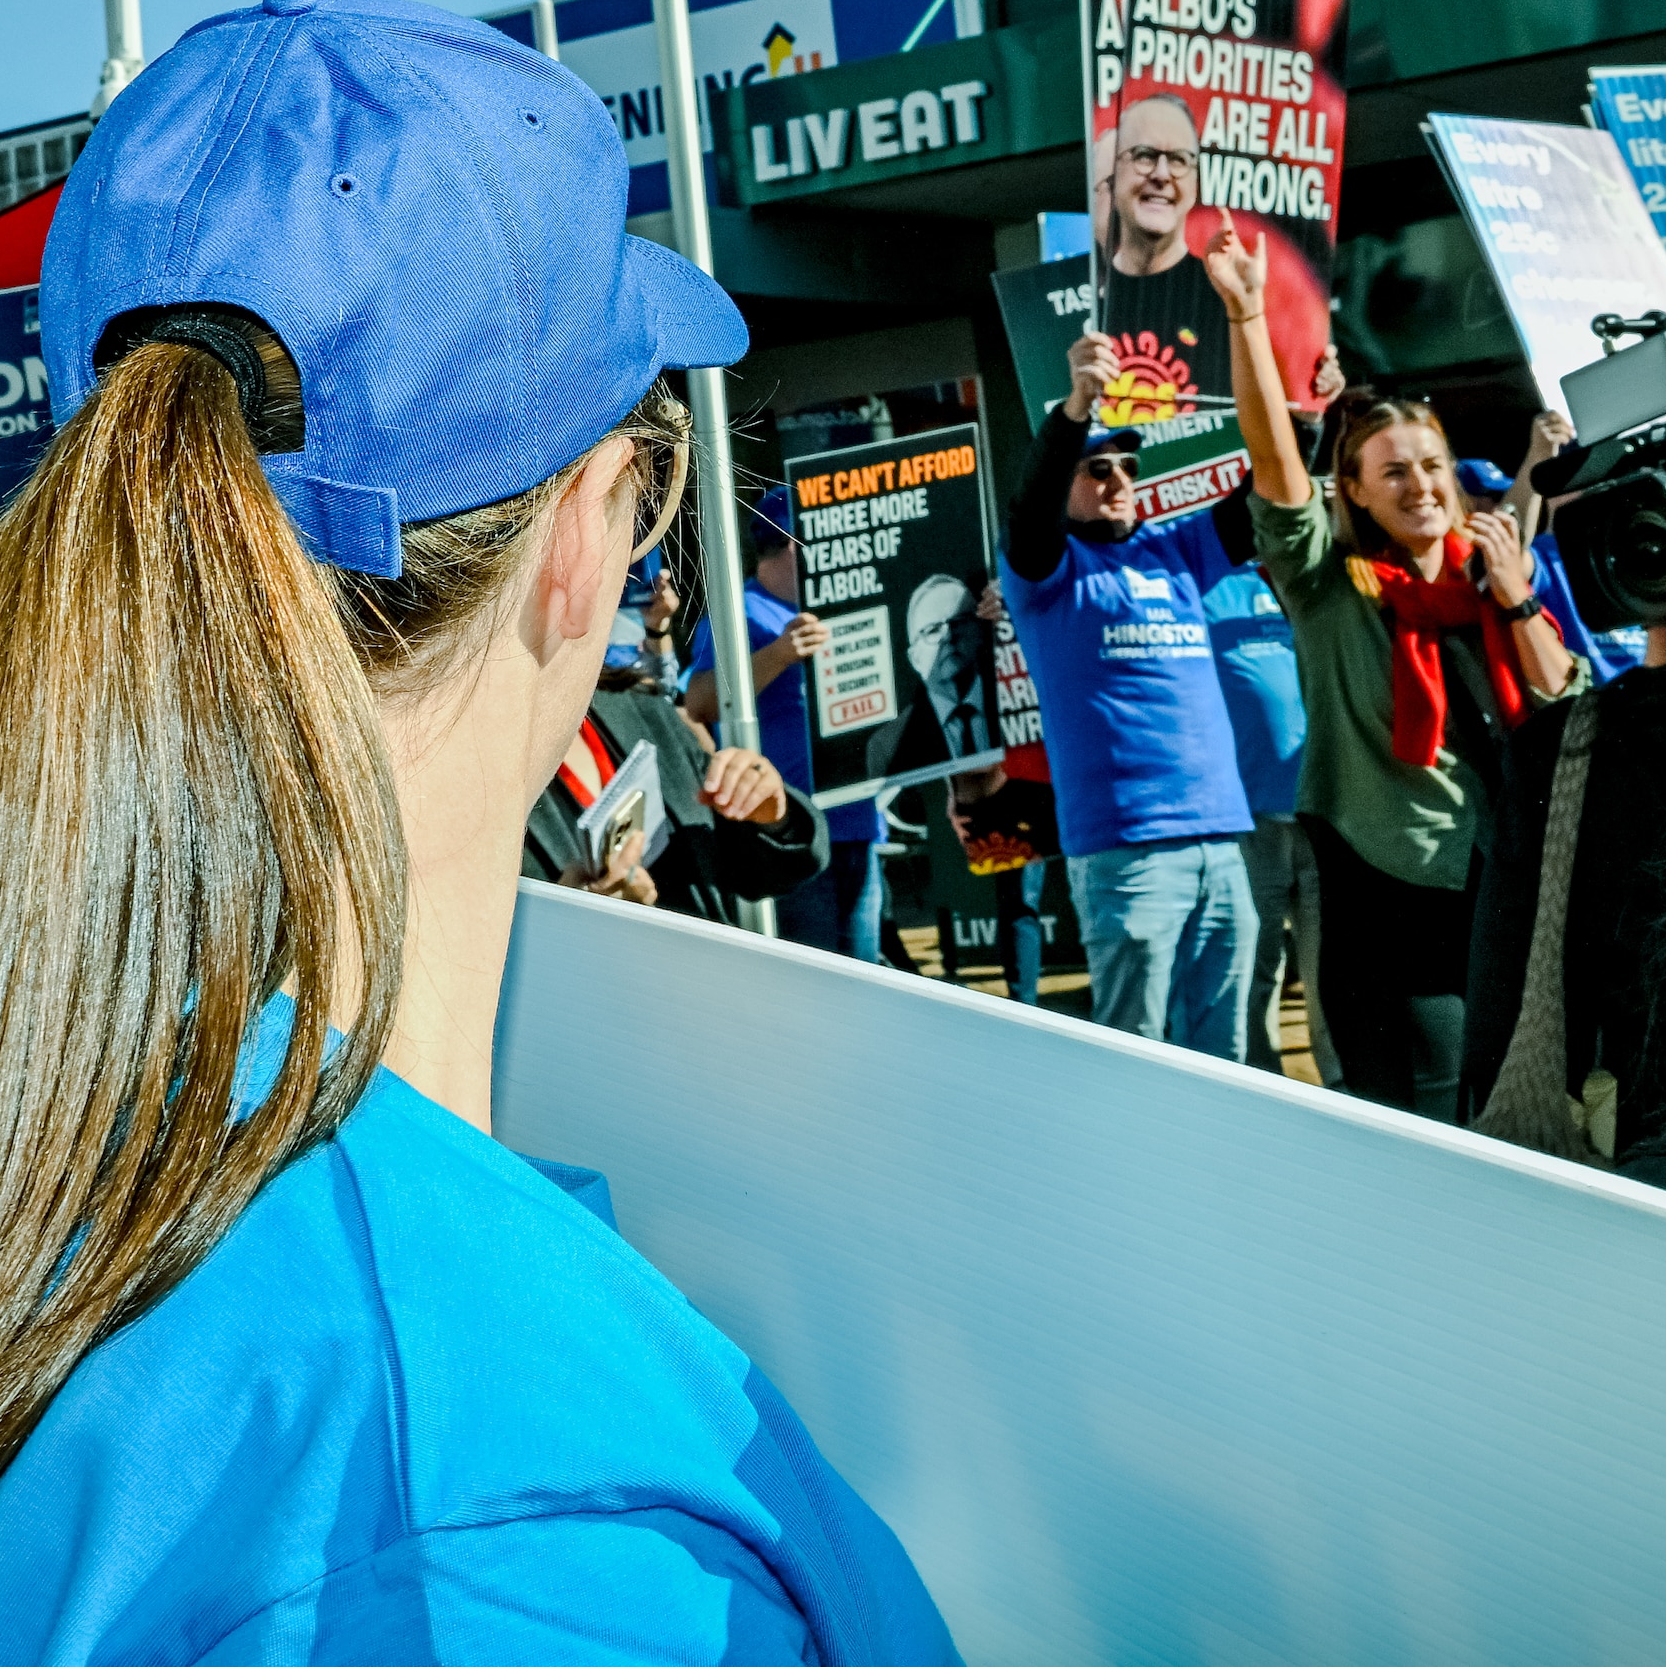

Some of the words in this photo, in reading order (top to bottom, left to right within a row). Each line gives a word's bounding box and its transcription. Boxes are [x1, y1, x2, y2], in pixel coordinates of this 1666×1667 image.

[1130, 25, 1314, 105] PRIORITIES
[1200, 97, 1272, 156] ARE
[1273, 107, 1334, 165] ALL
[1450, 130, 1552, 176] Every
[1199, 152, 1332, 221] WRONG.
[1470, 176, 1544, 211] litre
[1489, 220, 1560, 256] 25c
[797, 474, 833, 508] WE
[833, 461, 897, 501] CAN'T
[898, 445, 977, 488] AFFORD
[1156, 472, 1218, 511] RISK
[1217, 461, 1242, 492] IT
[799, 500, 870, 541] THREE
[870, 488, 930, 528] MORE
[802, 533, 873, 575] YEARS
[874, 527, 902, 560] OF
[804, 566, 883, 608] LABOR.
[841, 698, 875, 719] FAIL
